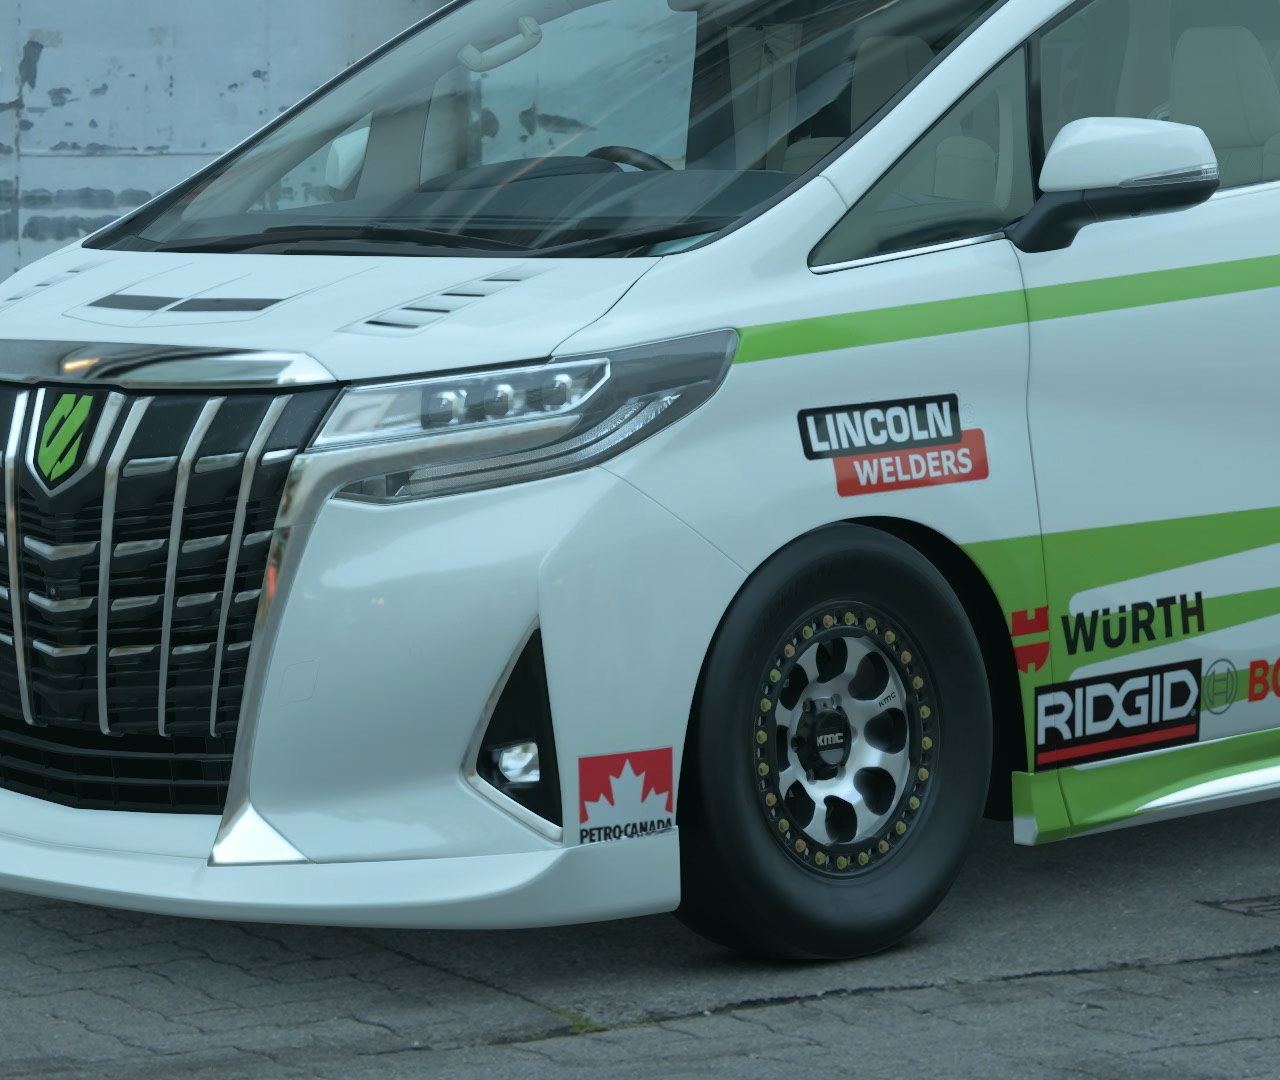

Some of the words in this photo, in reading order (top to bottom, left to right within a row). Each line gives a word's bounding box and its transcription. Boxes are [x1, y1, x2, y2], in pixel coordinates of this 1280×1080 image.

[806, 401, 954, 453] LINCOLN
[853, 448, 973, 486] WELDERS
[1061, 591, 1205, 656] WÜRTH
[1036, 668, 1199, 746] RIDGID
[816, 732, 844, 747] KMC
[580, 818, 672, 844] PETRO-CANADA
